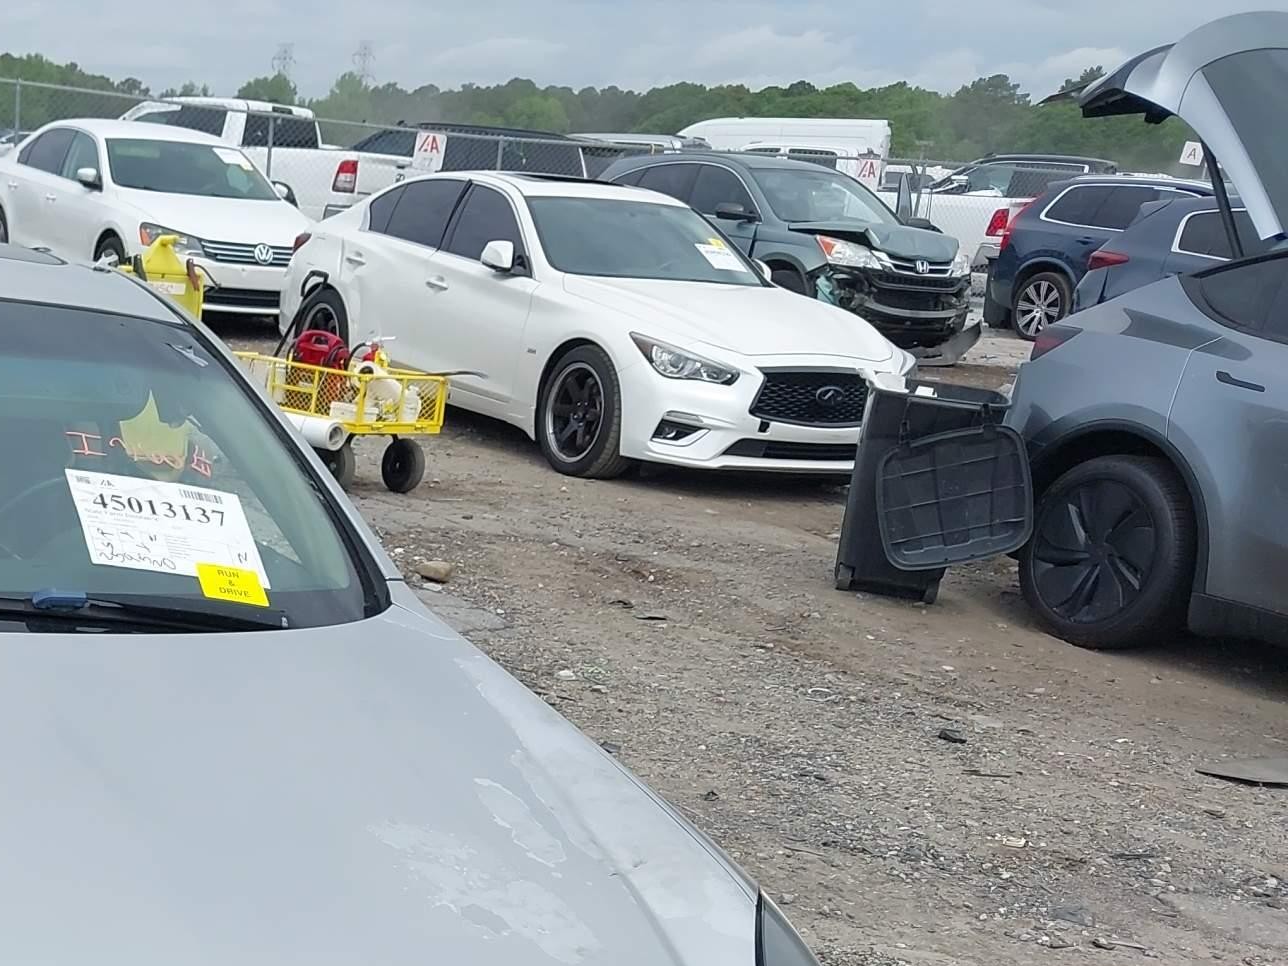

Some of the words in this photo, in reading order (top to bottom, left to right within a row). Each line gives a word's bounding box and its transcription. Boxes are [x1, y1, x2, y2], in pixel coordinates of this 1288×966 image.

[93, 493, 224, 526] 45013137
[217, 569, 239, 579] RUN
[219, 587, 253, 598] DRIVE
